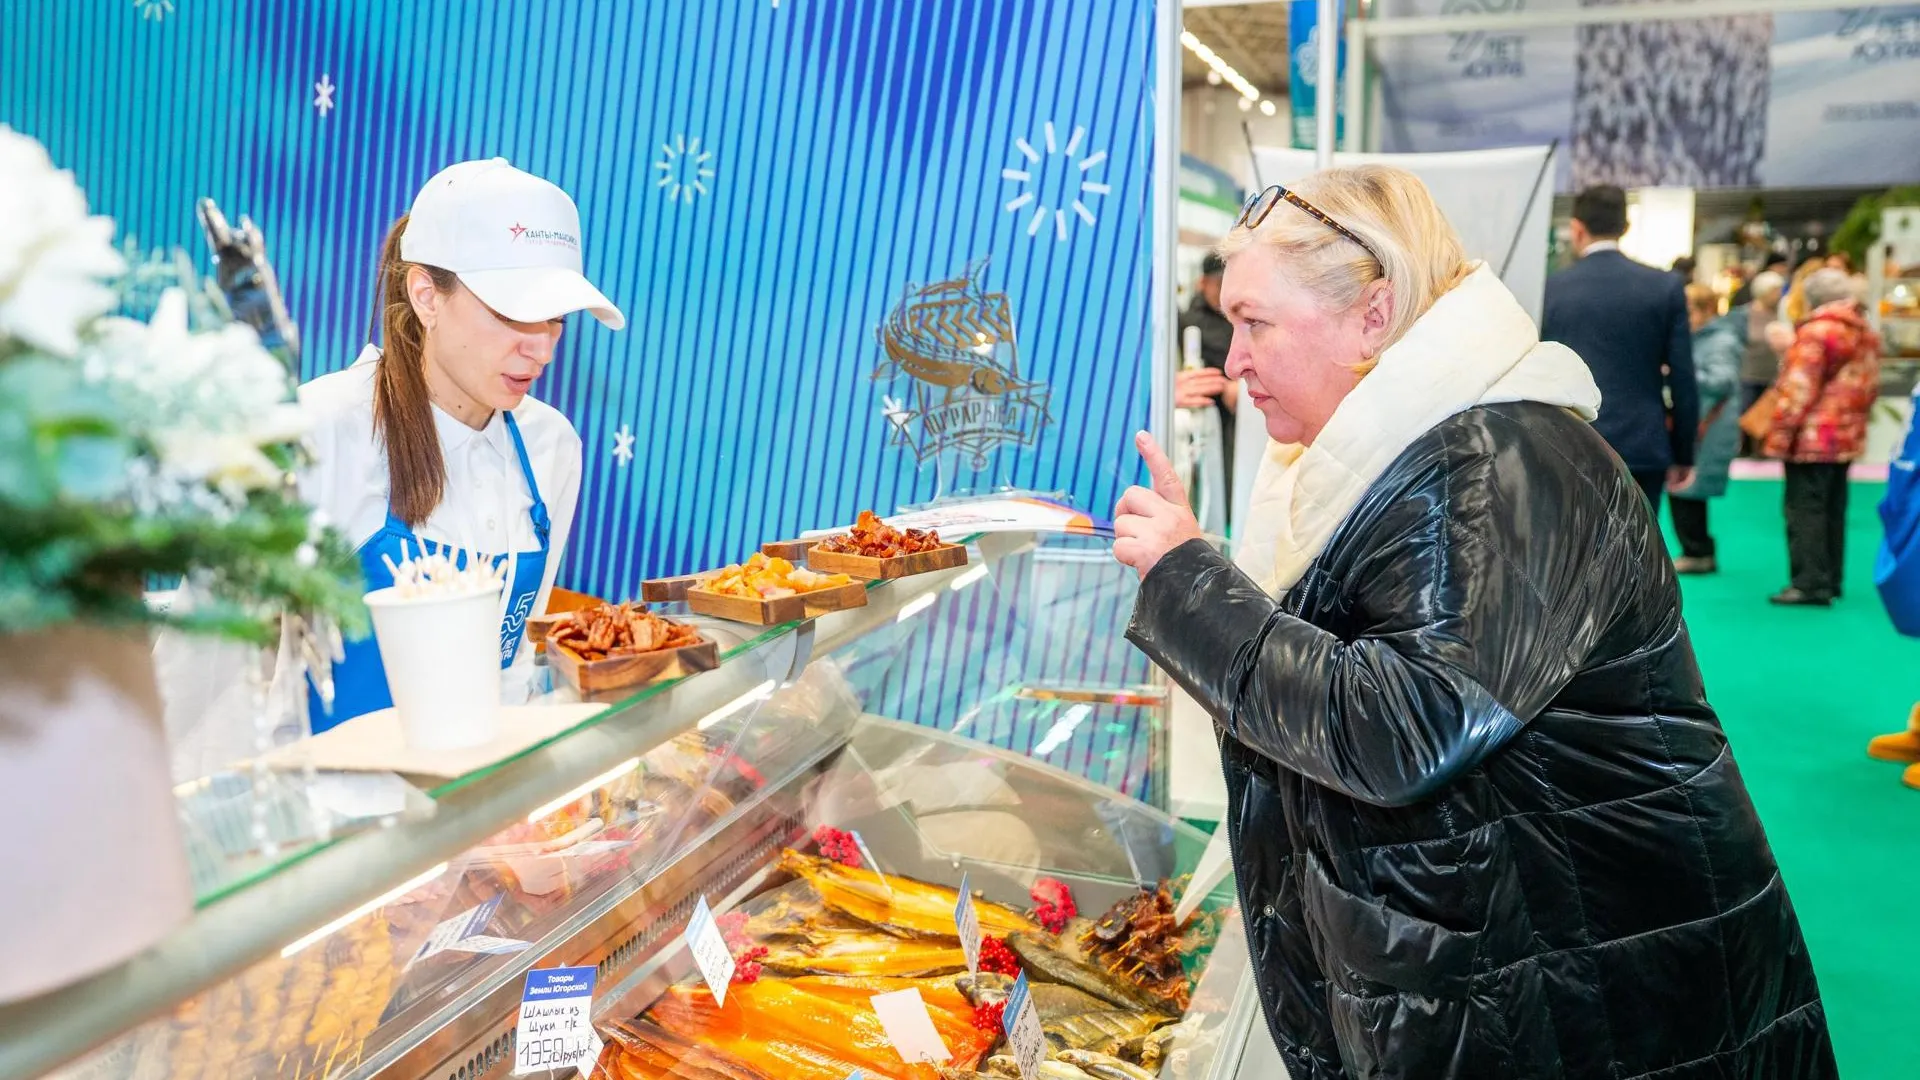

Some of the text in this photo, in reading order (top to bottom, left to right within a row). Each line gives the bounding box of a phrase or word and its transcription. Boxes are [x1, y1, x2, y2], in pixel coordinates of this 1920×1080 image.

[547, 974, 575, 984] Товары
[529, 982, 588, 996] Земли Югорской
[523, 1005, 580, 1019] Шашлык из
[529, 1020, 556, 1036] Щуки
